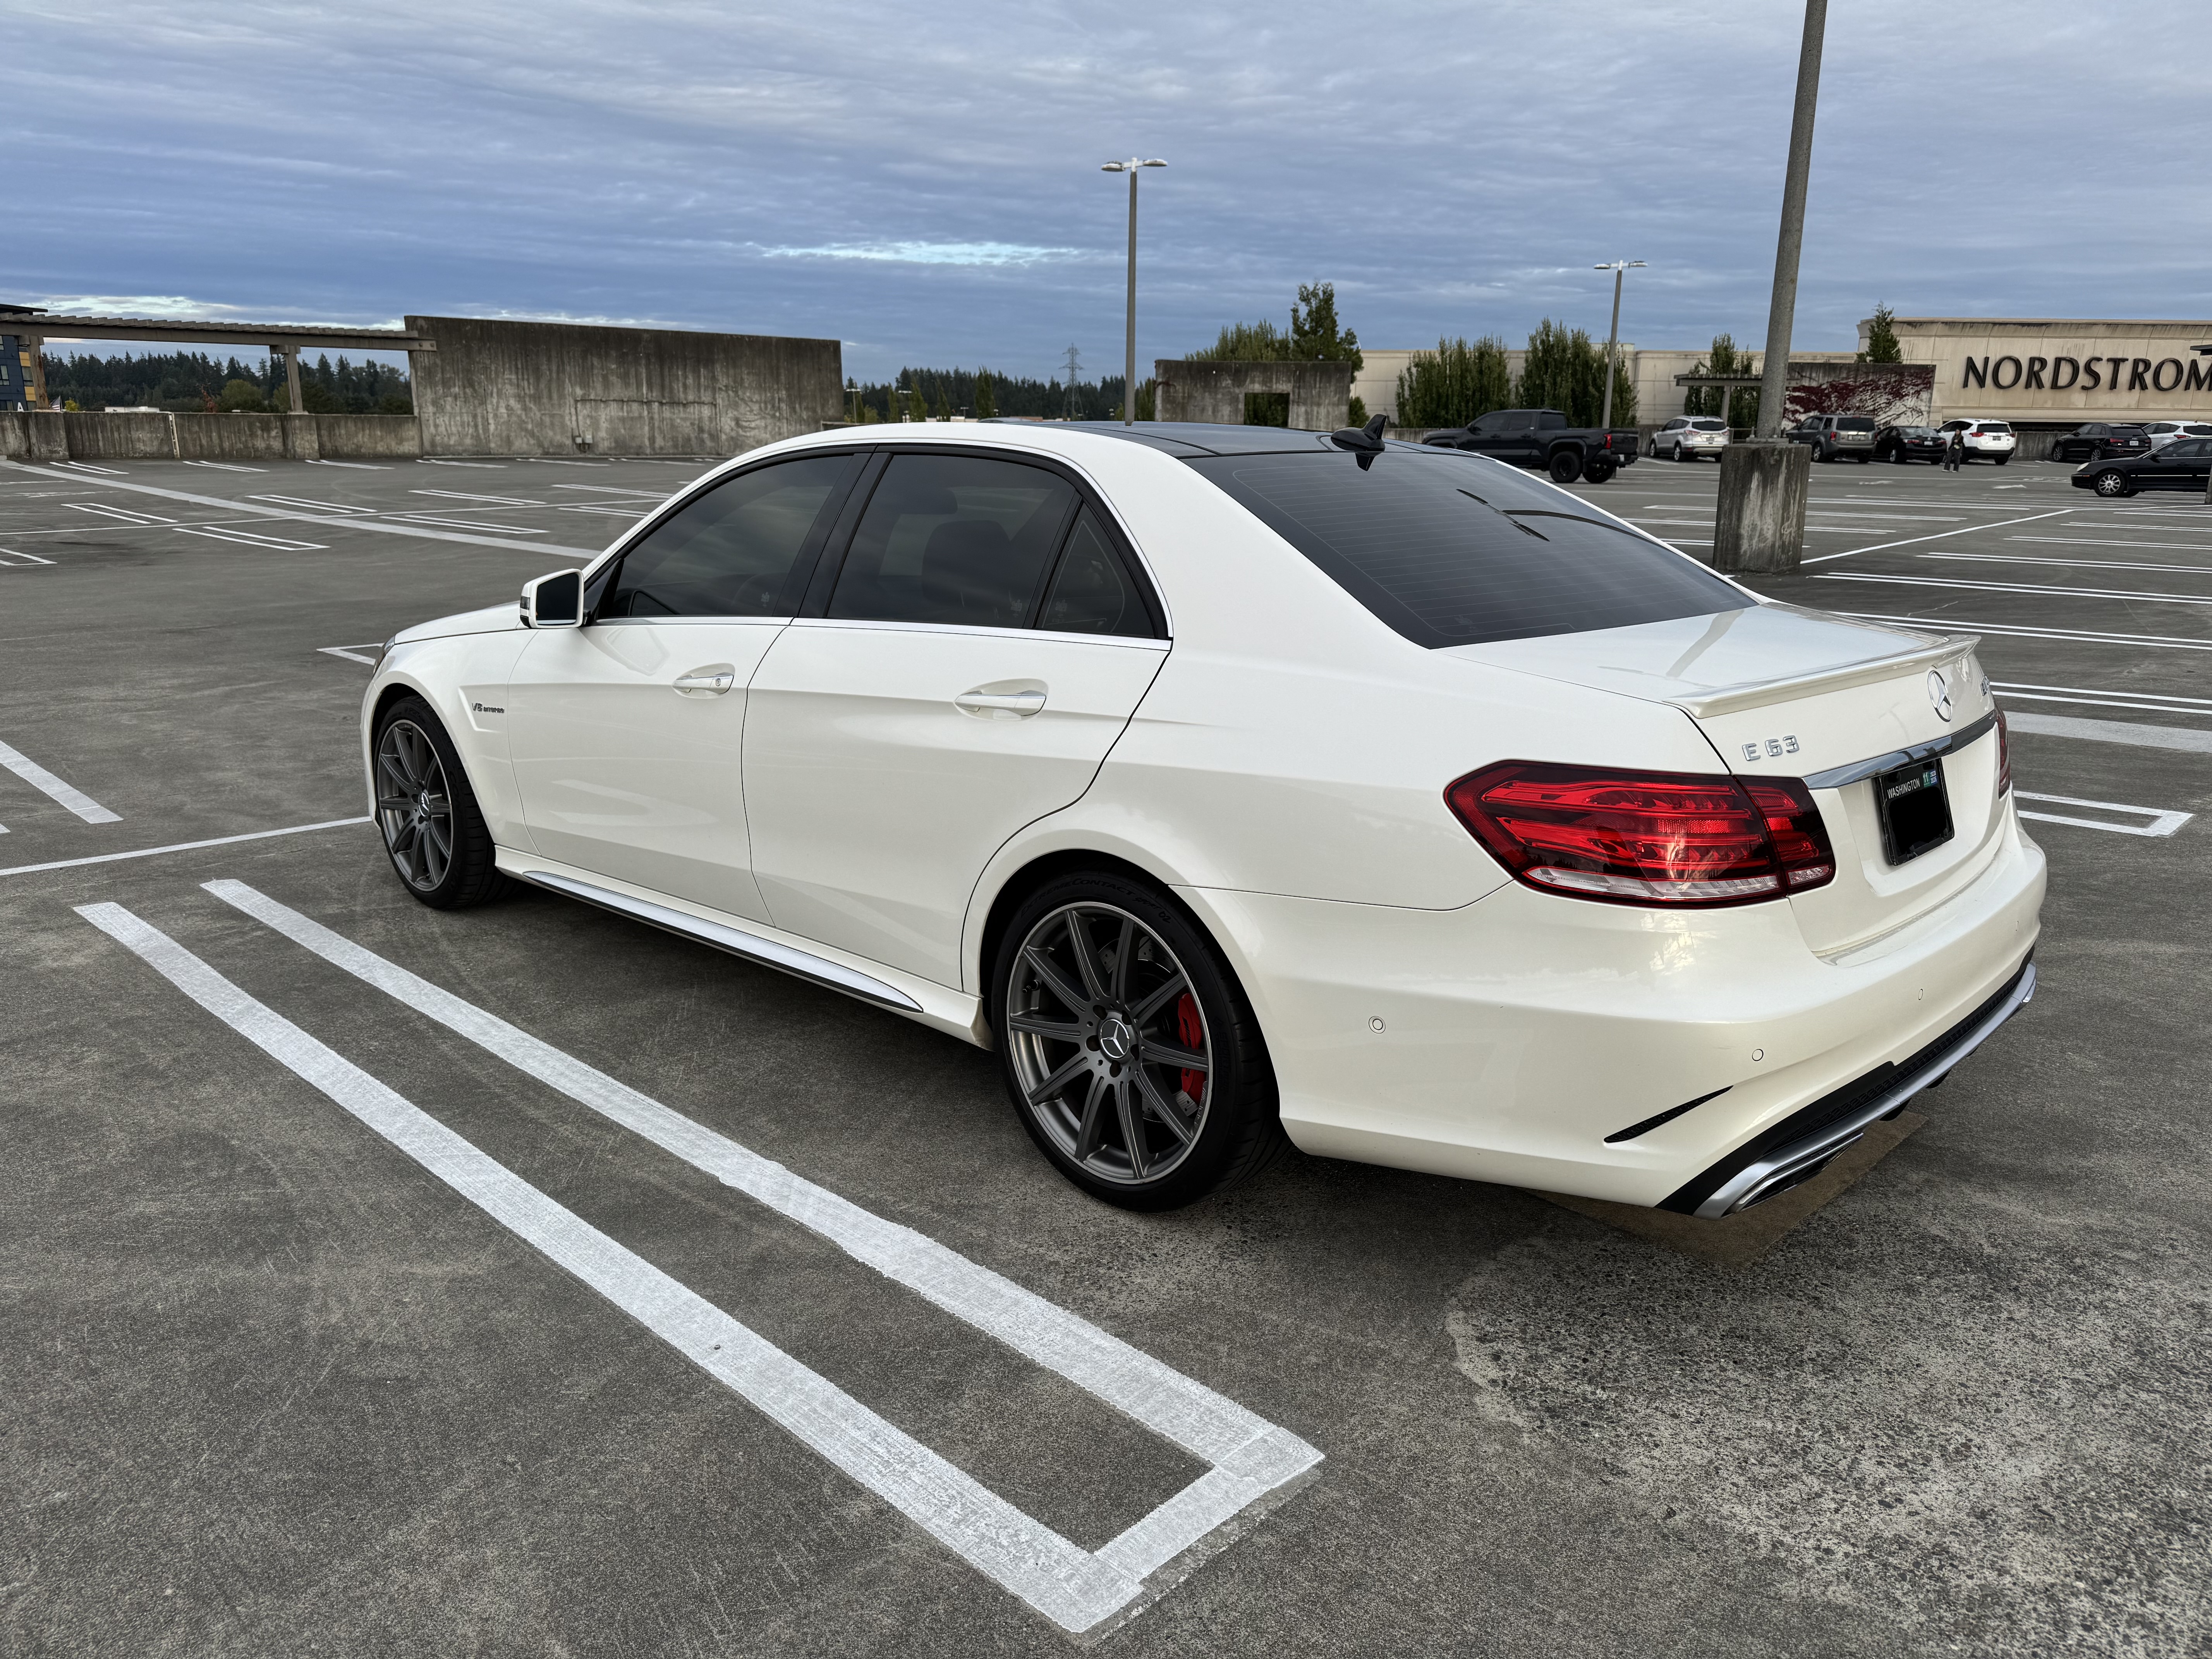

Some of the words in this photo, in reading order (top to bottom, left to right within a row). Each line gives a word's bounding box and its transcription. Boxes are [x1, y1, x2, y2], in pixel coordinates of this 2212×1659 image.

[1963, 356, 2212, 391] NORDSTROM
[1742, 743, 1761, 761] E
[1764, 735, 1800, 757] 63
[1887, 778, 1920, 799] WASHINGTON
